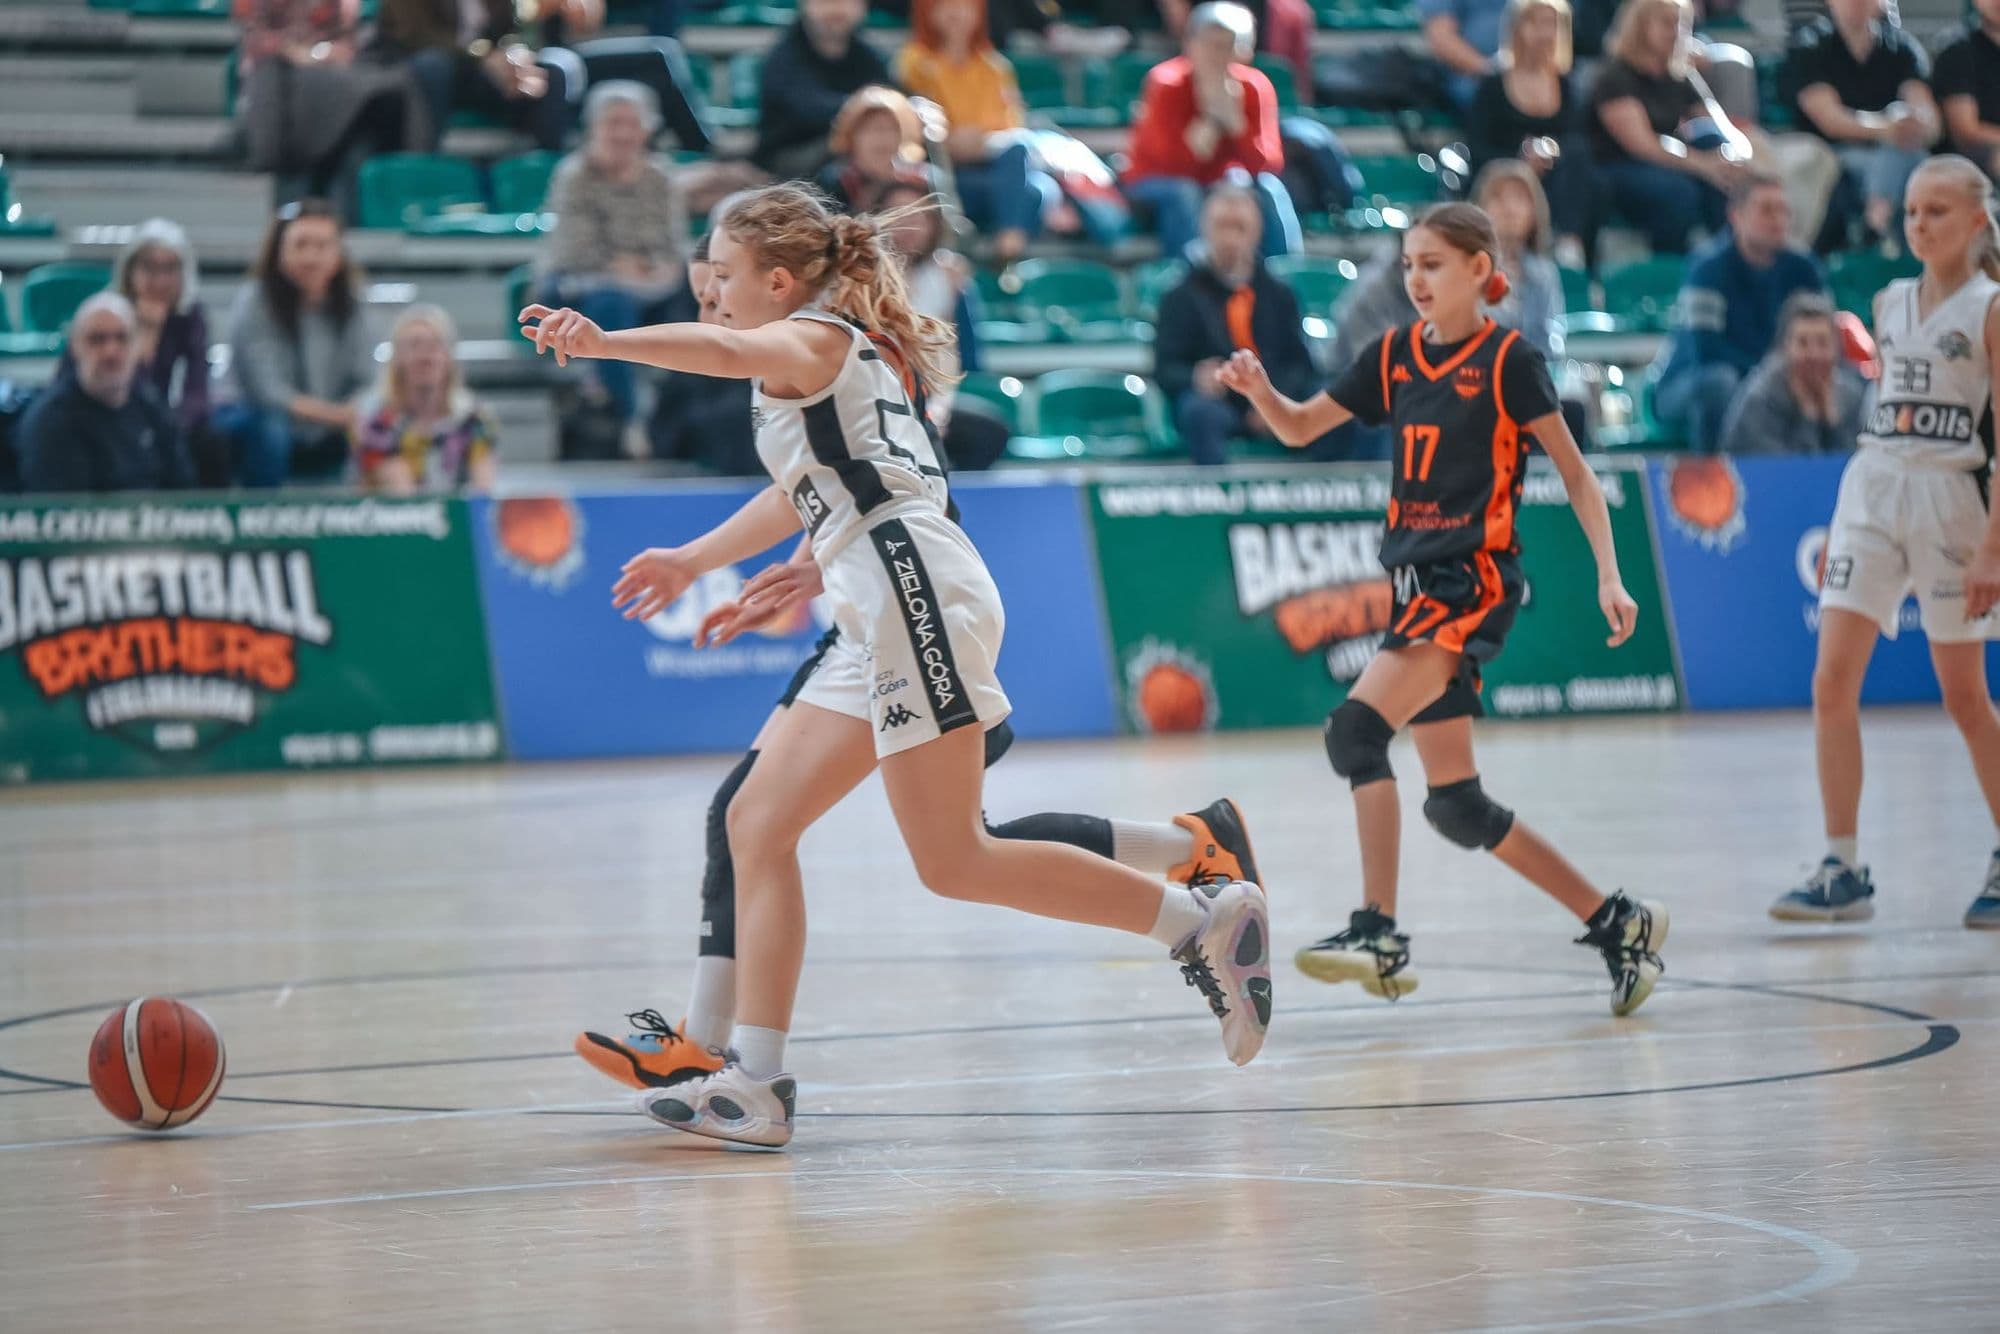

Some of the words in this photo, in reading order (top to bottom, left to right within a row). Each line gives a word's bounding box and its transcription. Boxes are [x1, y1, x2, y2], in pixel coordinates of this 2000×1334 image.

[1402, 424, 1440, 482] 17
[893, 556, 933, 649] ZIELONA
[922, 647, 956, 709] GÓRA
[1393, 594, 1450, 638] 17
[878, 678, 908, 696] Góra
